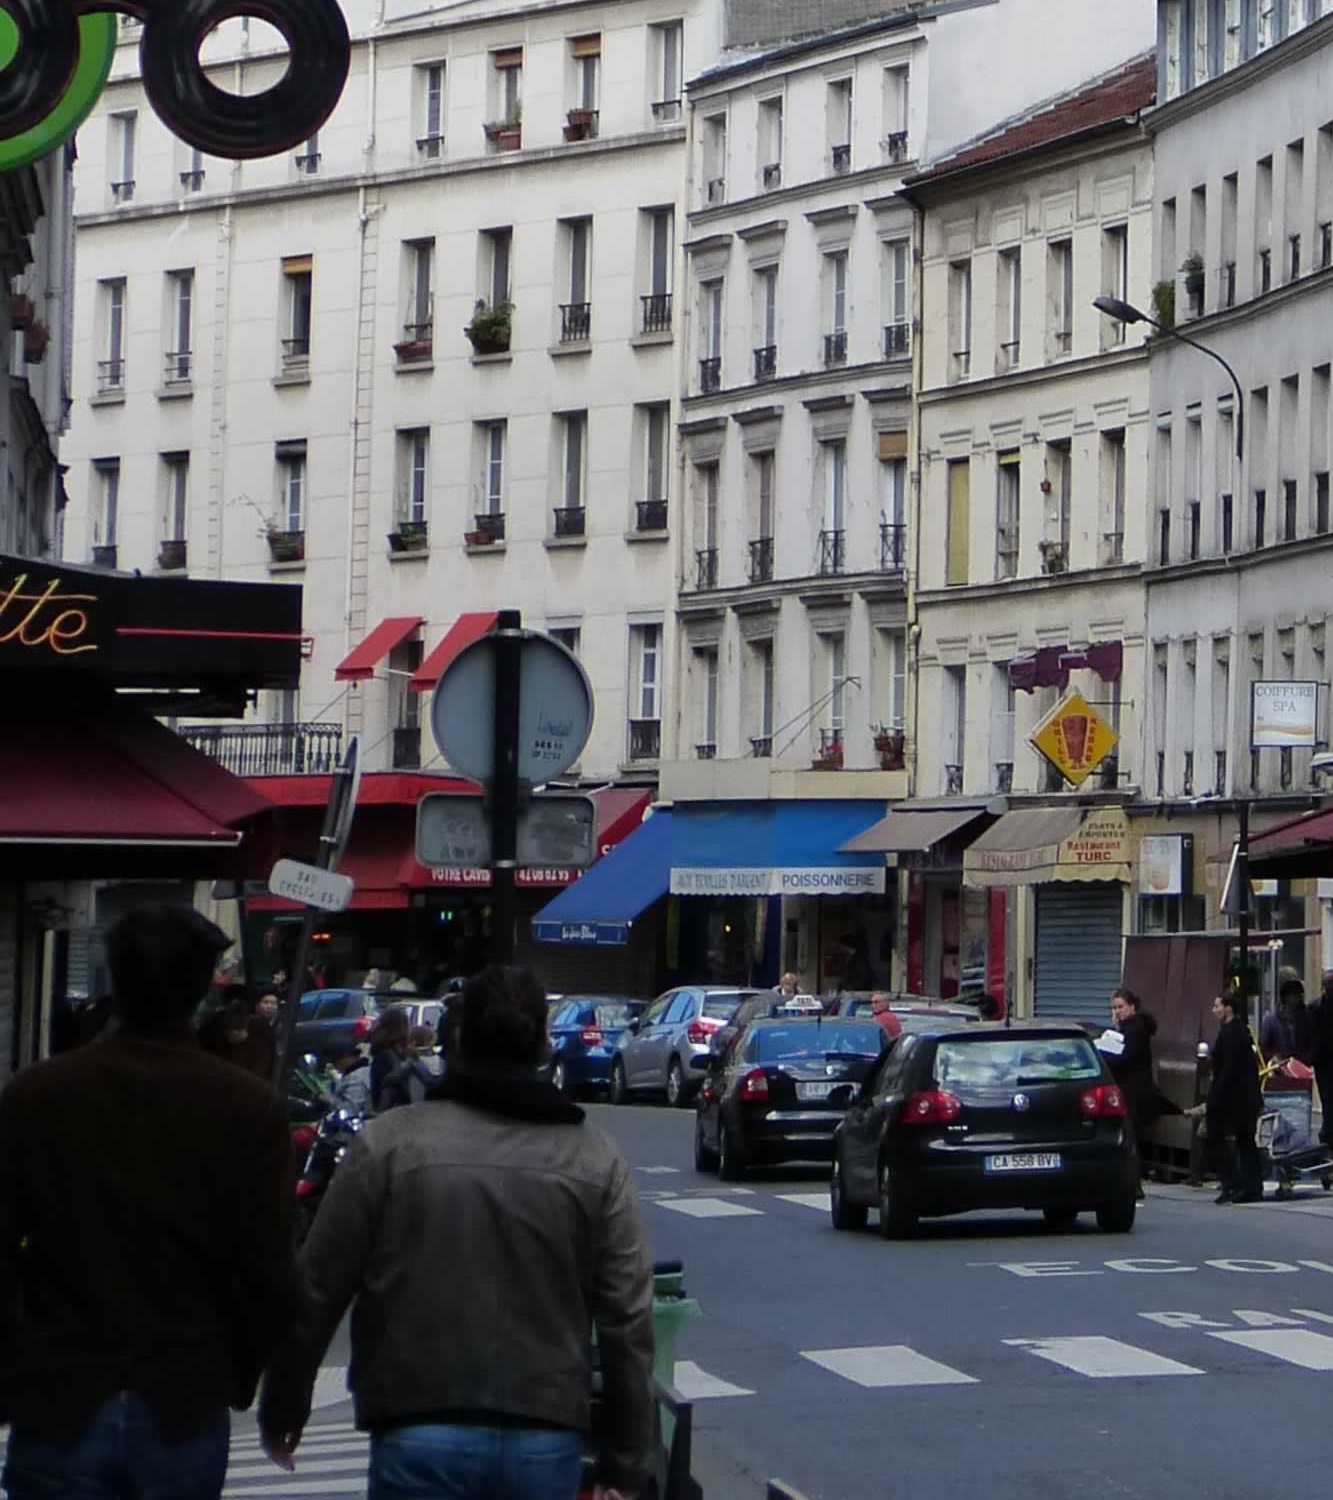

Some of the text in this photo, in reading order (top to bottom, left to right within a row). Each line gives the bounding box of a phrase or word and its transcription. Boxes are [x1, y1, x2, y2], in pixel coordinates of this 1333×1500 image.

[1256, 685, 1314, 697] COIFFURE
[1272, 700, 1297, 712] SPA
[1076, 851, 1112, 862] TURC
[782, 873, 875, 886] POISSONNERIE
